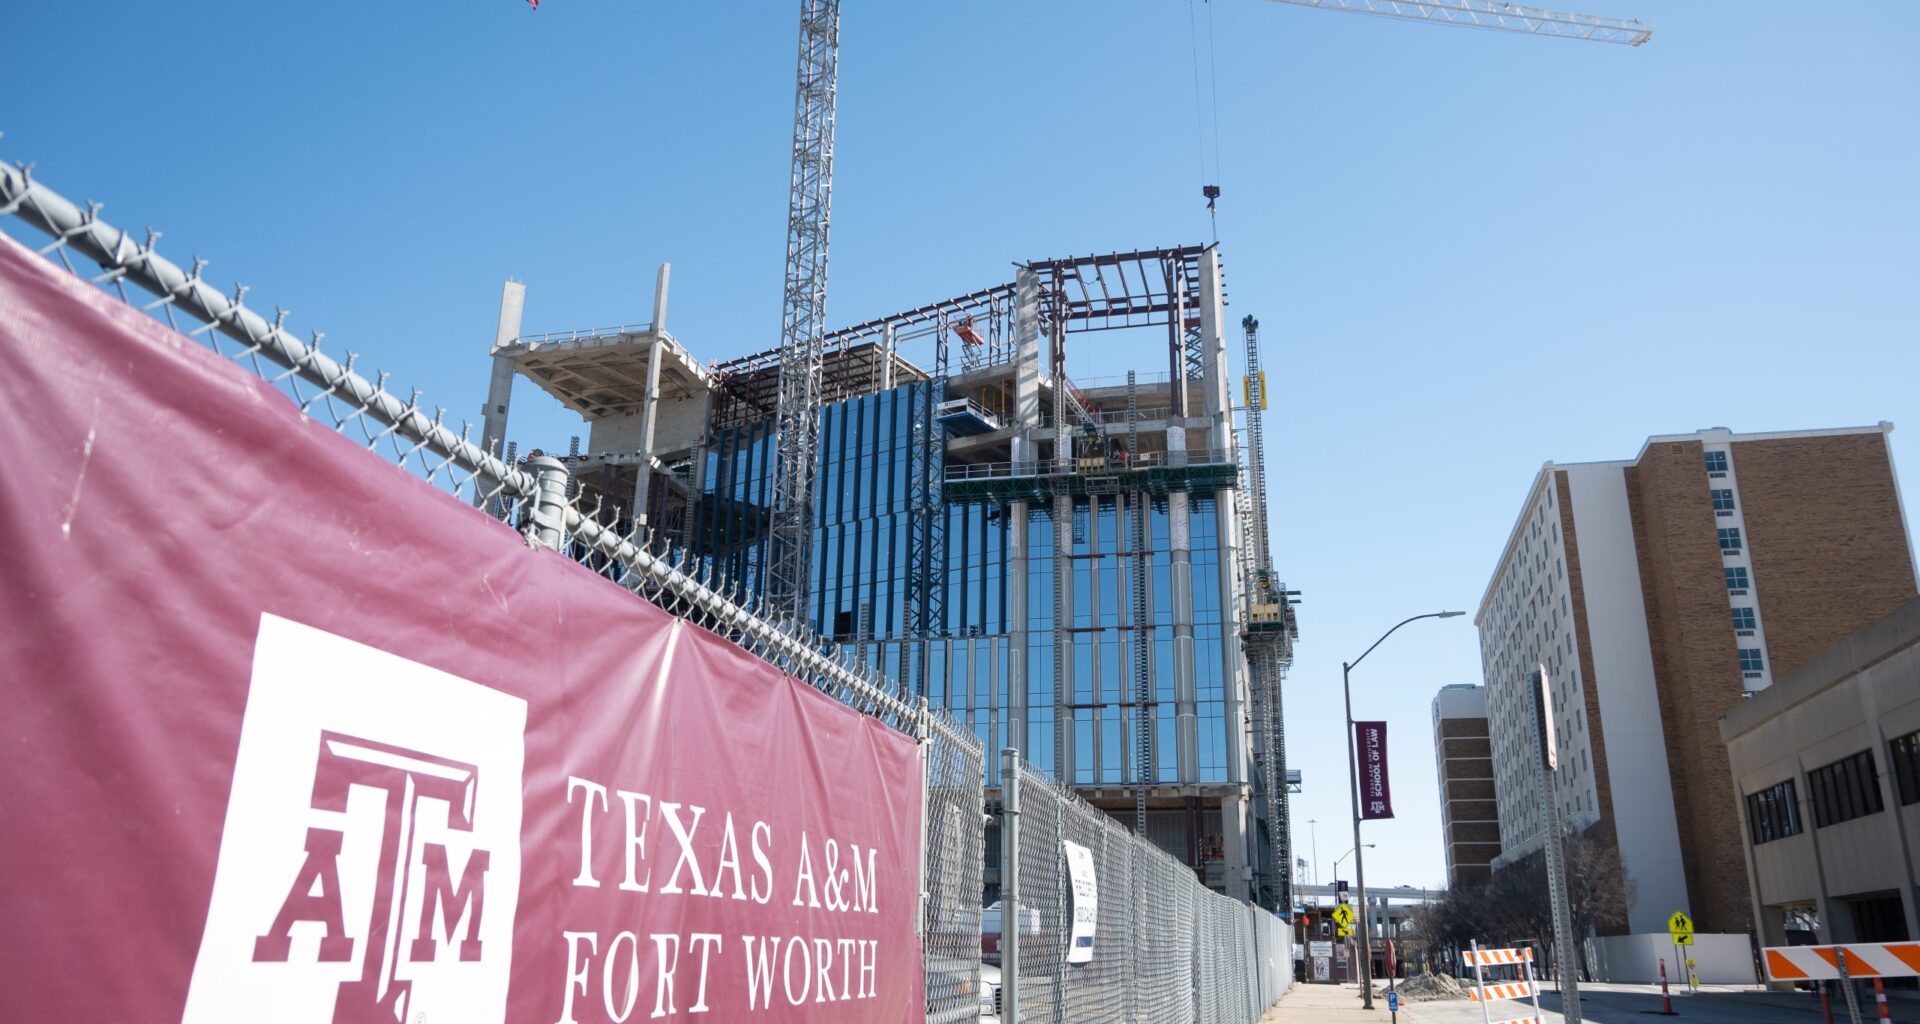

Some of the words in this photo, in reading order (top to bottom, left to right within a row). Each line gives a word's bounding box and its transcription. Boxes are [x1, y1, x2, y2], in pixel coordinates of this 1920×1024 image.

[1370, 728, 1378, 748] LAW
[1372, 750, 1380, 761] OF
[1373, 762, 1382, 797] SCHOOL
[567, 776, 773, 904] TEXAS
[793, 831, 879, 913] A&M
[554, 931, 722, 1024] FORT
[742, 936, 878, 1010] WORTH
